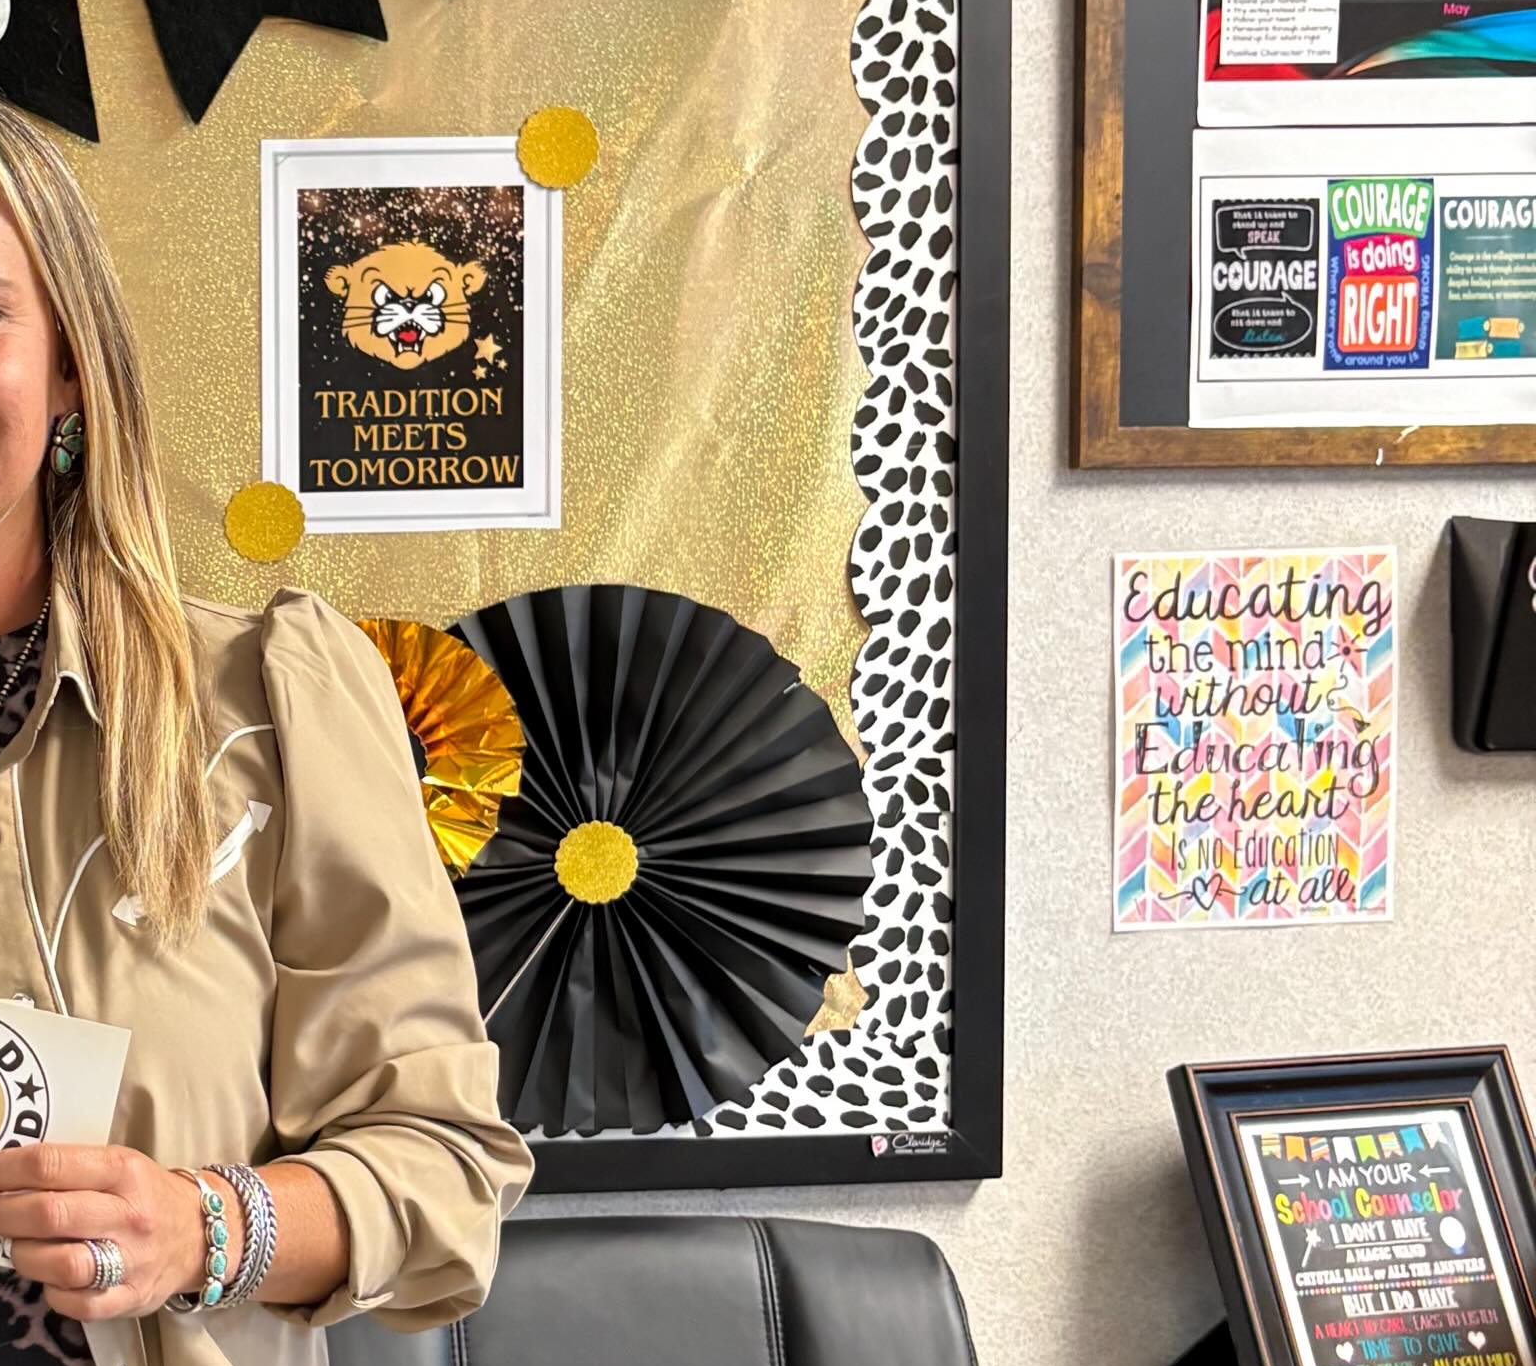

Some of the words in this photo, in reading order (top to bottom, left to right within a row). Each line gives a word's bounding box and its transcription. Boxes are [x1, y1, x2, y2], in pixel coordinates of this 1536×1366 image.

[1443, 3, 1470, 16] May
[1332, 183, 1430, 232] COURAGE
[1248, 231, 1280, 244] SPEAK
[1347, 245, 1360, 269] is
[1362, 237, 1417, 272] doing
[1213, 260, 1317, 291] COURAGE
[1343, 282, 1417, 346] RIGHT
[1345, 354, 1383, 366] around
[1386, 354, 1406, 367] you
[313, 387, 504, 418] TRADITION
[353, 422, 467, 452] MEETS
[309, 455, 520, 487] TOMORROW
[1123, 567, 1392, 636] Educating
[1144, 635, 1214, 674] the
[1228, 632, 1326, 672] mind
[1156, 676, 1323, 717] without
[1134, 719, 1380, 798] Educating
[1148, 780, 1221, 825] the
[1228, 776, 1350, 822] heart
[1249, 871, 1289, 905] at
[1298, 869, 1356, 903] all.
[1316, 1170, 1323, 1189] I
[1328, 1167, 1359, 1187] AM
[1359, 1163, 1417, 1186] YOUR
[1275, 1190, 1352, 1225] School
[1355, 1182, 1462, 1218] Counselor
[1330, 1224, 1340, 1243] I
[1343, 1220, 1387, 1243] DON'T
[1392, 1217, 1430, 1239] HAVE
[1346, 1250, 1354, 1263] A
[1355, 1247, 1392, 1262] MAGIC
[1392, 1244, 1426, 1259] WAND
[1295, 1266, 1344, 1286] CRYSTAL
[1344, 1266, 1374, 1283] BALL
[1388, 1263, 1410, 1279] ALL
[1409, 1262, 1433, 1276] THE
[1433, 1257, 1486, 1275] ANSWERS
[1342, 1292, 1374, 1314] BUT
[1378, 1292, 1389, 1311] I
[1393, 1290, 1415, 1310] DO
[1418, 1286, 1458, 1308] HAVE
[1315, 1324, 1324, 1340] A
[1446, 1313, 1460, 1328] TO
[1462, 1309, 1499, 1326] LISTEN
[1357, 1338, 1393, 1360] TIME
[1401, 1336, 1422, 1356] TO
[1427, 1332, 1464, 1354] GIVE
